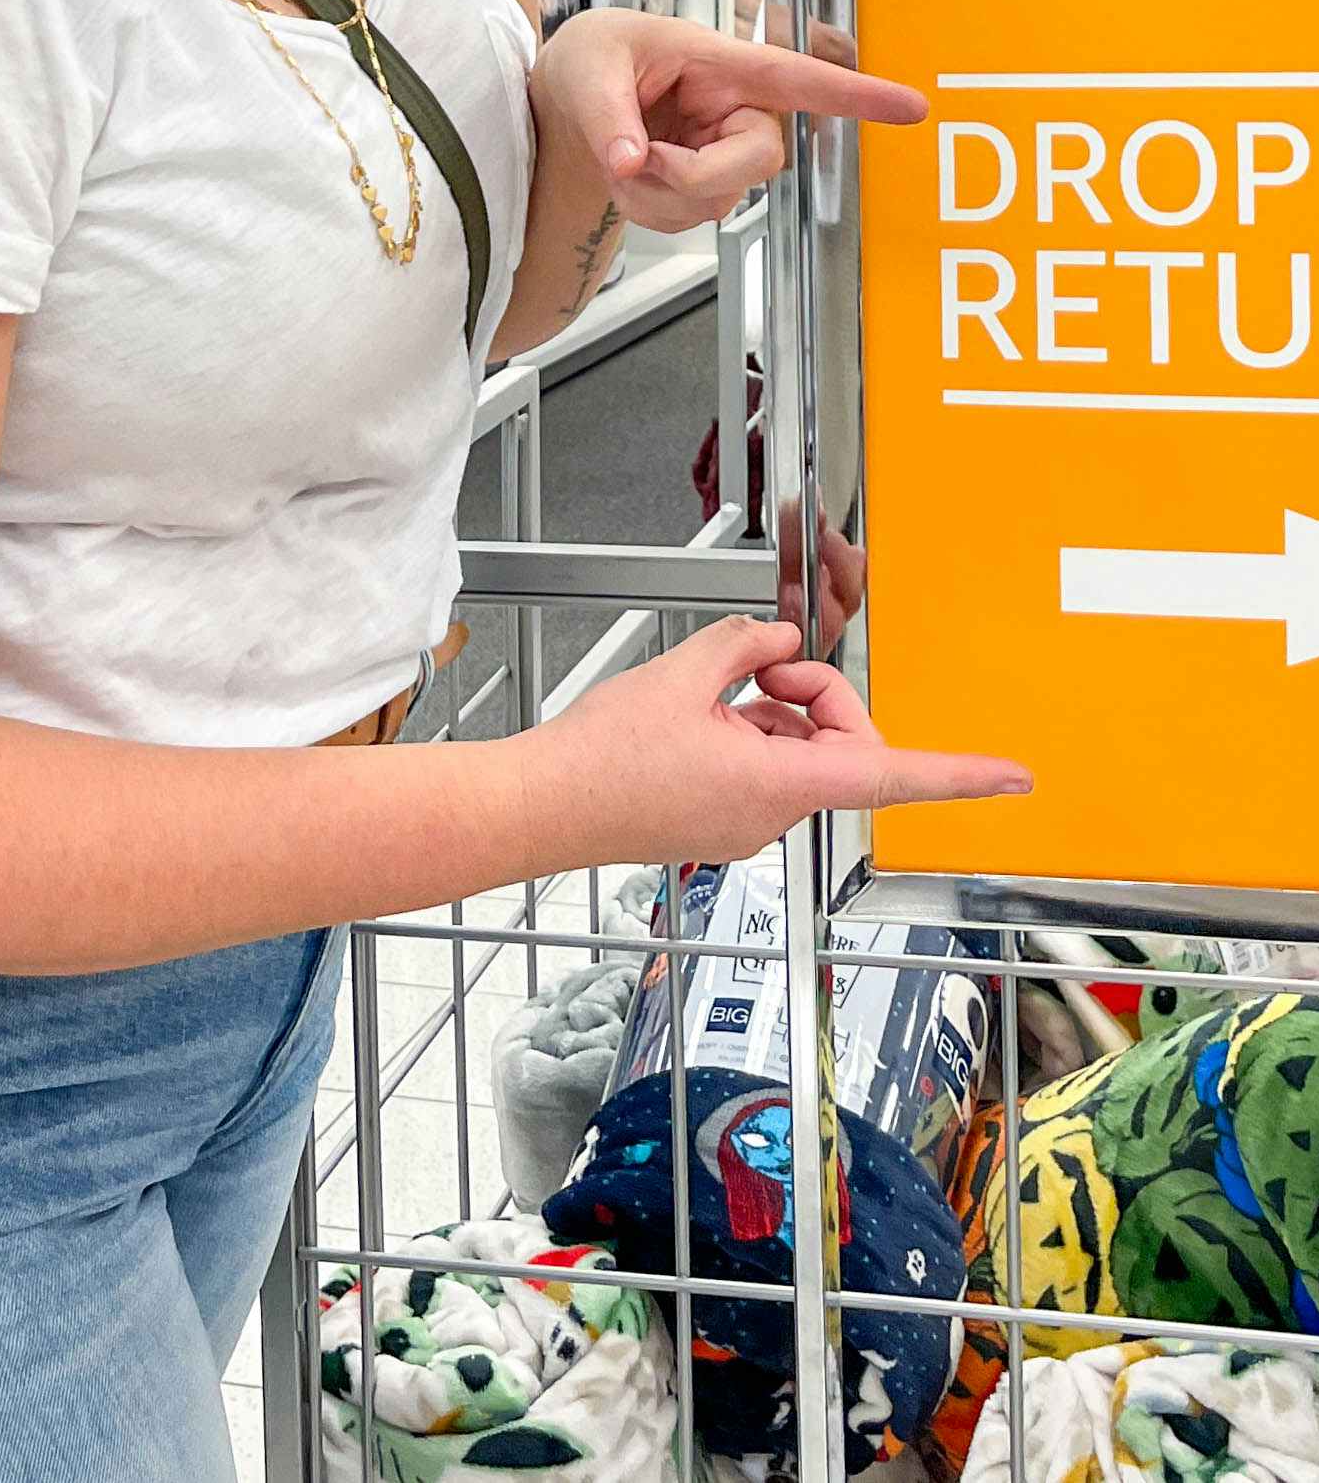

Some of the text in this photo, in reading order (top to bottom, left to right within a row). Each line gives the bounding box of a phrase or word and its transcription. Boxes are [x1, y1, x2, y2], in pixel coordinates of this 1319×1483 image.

[938, 119, 1310, 227] DROP
[710, 1006, 749, 1024] BIG
[937, 1032, 970, 1088] BIG
